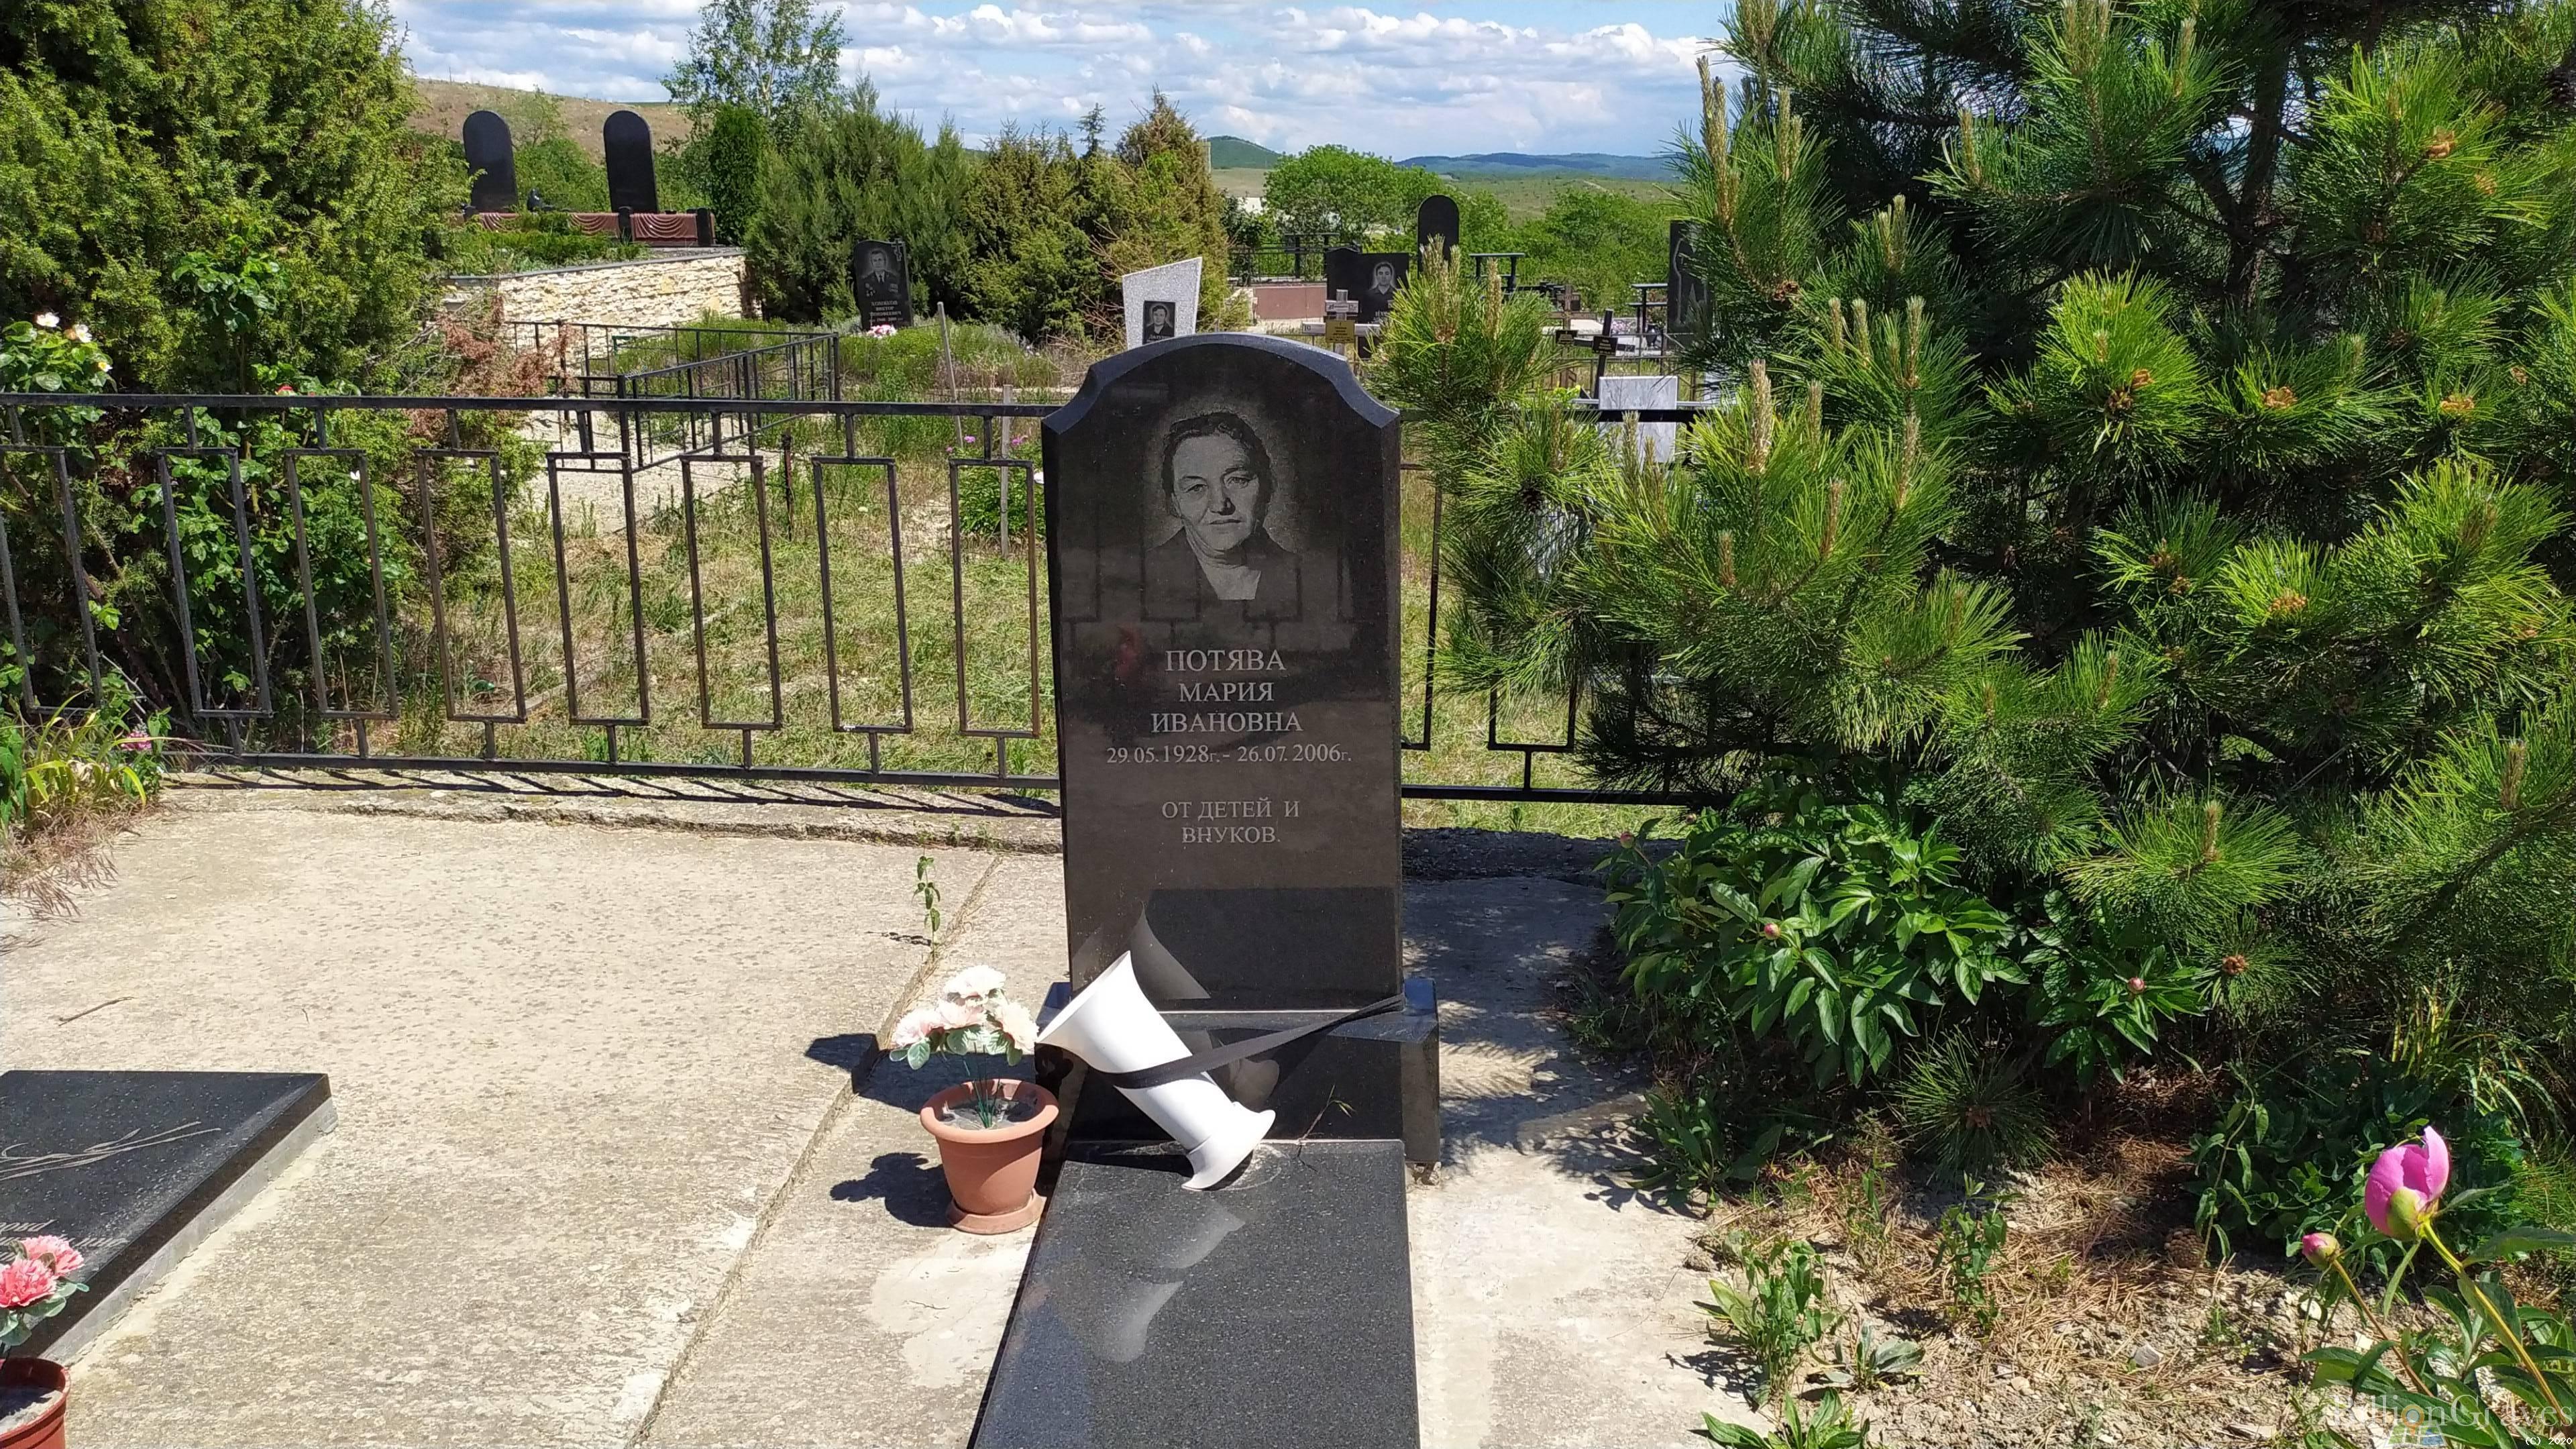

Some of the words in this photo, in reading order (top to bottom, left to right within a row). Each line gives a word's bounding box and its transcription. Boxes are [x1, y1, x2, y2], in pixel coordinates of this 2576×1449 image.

[1165, 649, 1287, 672] ПОТЯВА
[1179, 682, 1275, 702] МАРИЯ
[1150, 711, 1304, 733] ИВАНОВНА
[1162, 801, 1192, 819] ОТ
[1197, 796, 1273, 822] ДЕТЕЙ
[1284, 800, 1300, 817] И
[1181, 826, 1281, 844] ВНУКОВ.
